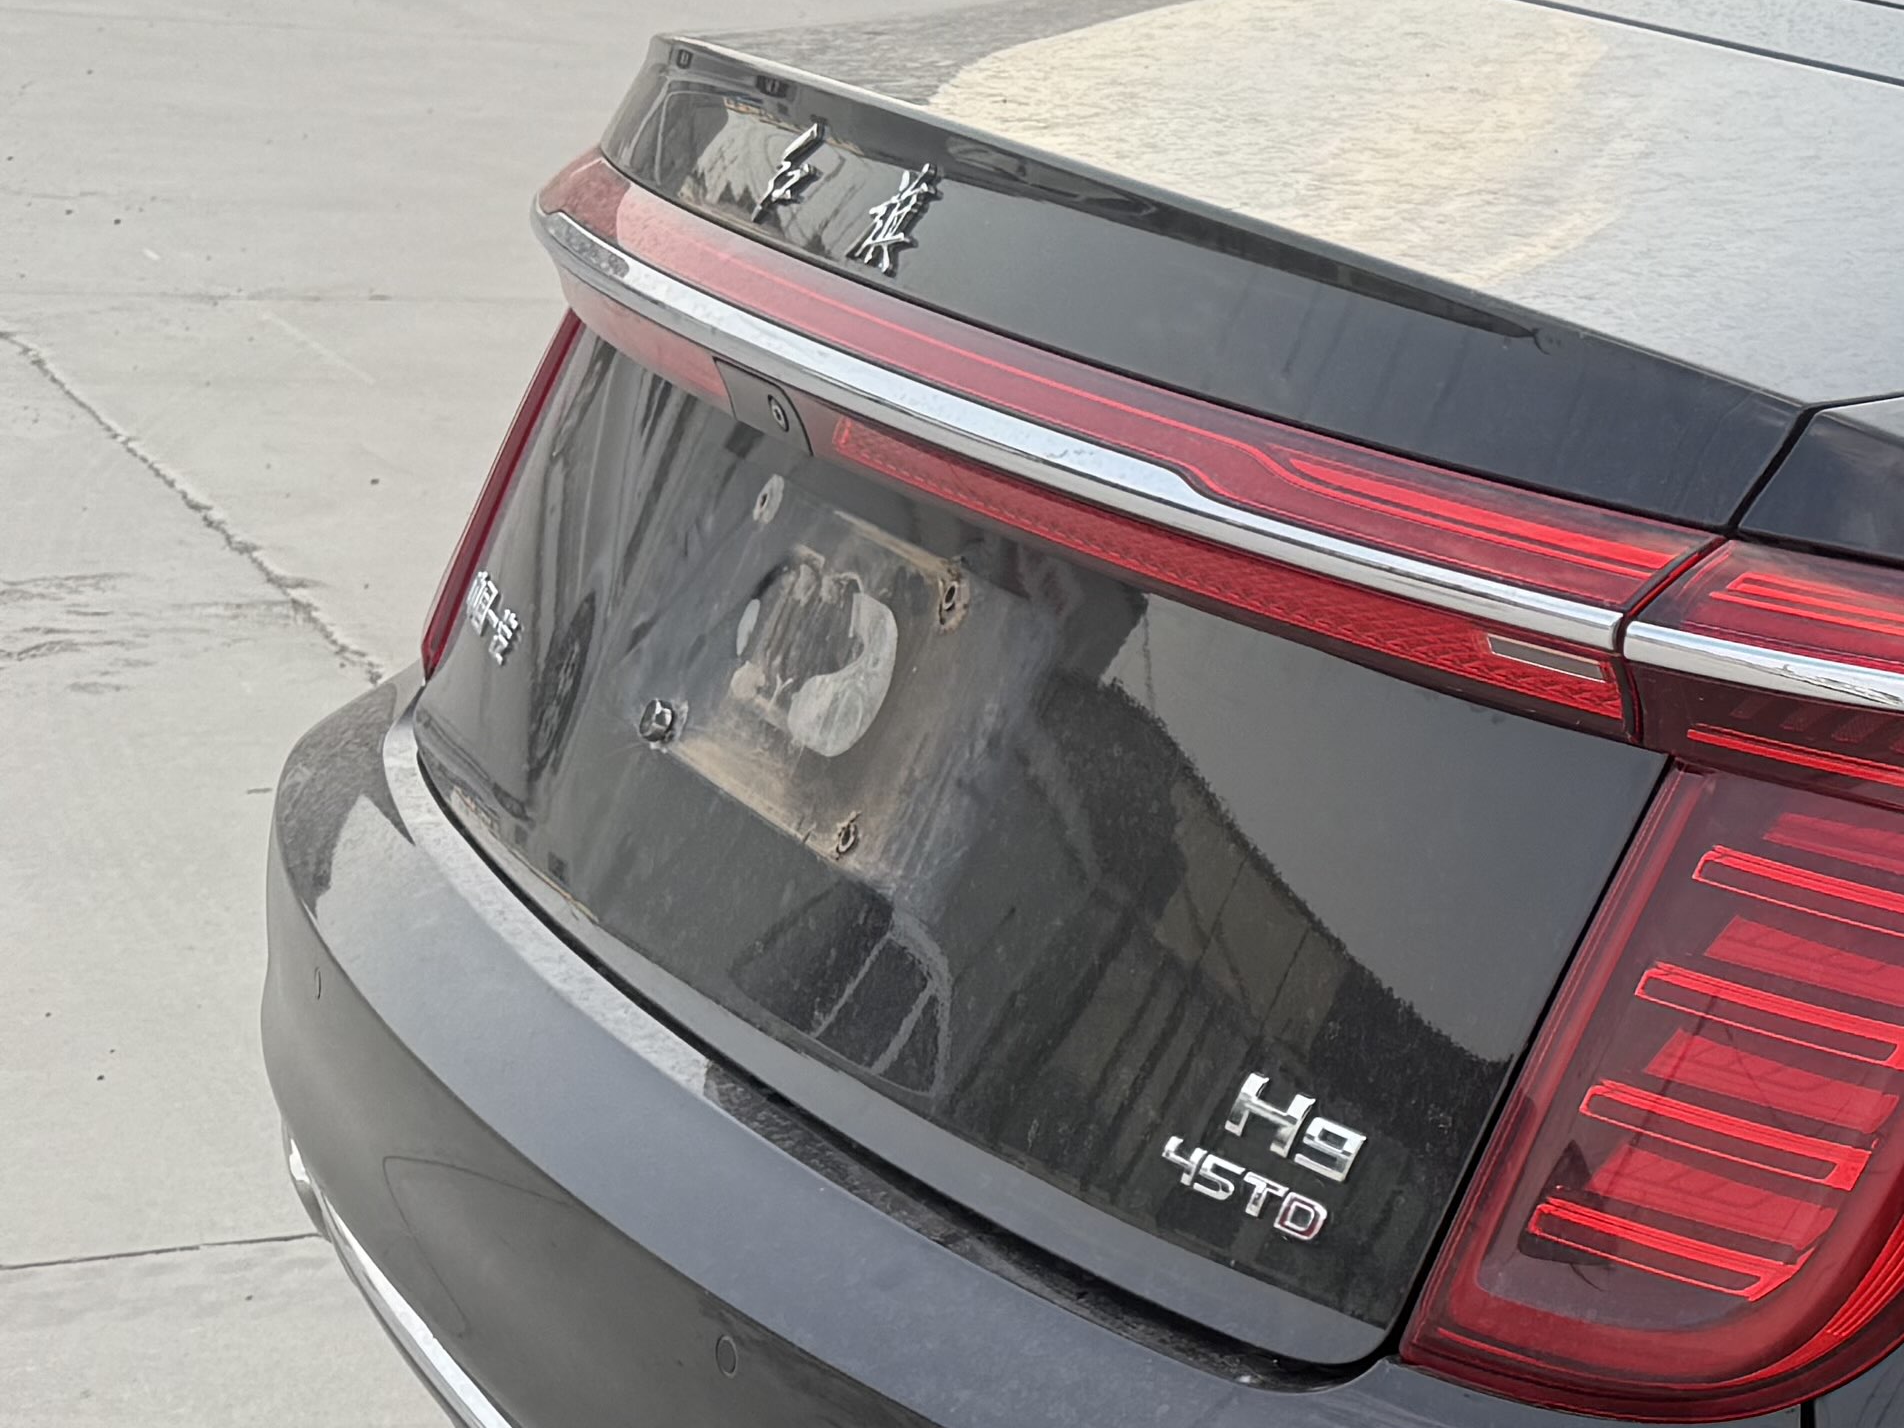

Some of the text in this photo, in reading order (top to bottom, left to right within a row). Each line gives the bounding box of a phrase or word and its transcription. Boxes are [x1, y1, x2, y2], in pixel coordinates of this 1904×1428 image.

[752, 122, 934, 274] 红旗
[1224, 1072, 1367, 1183] H9
[1162, 1135, 1328, 1241] 45TD
